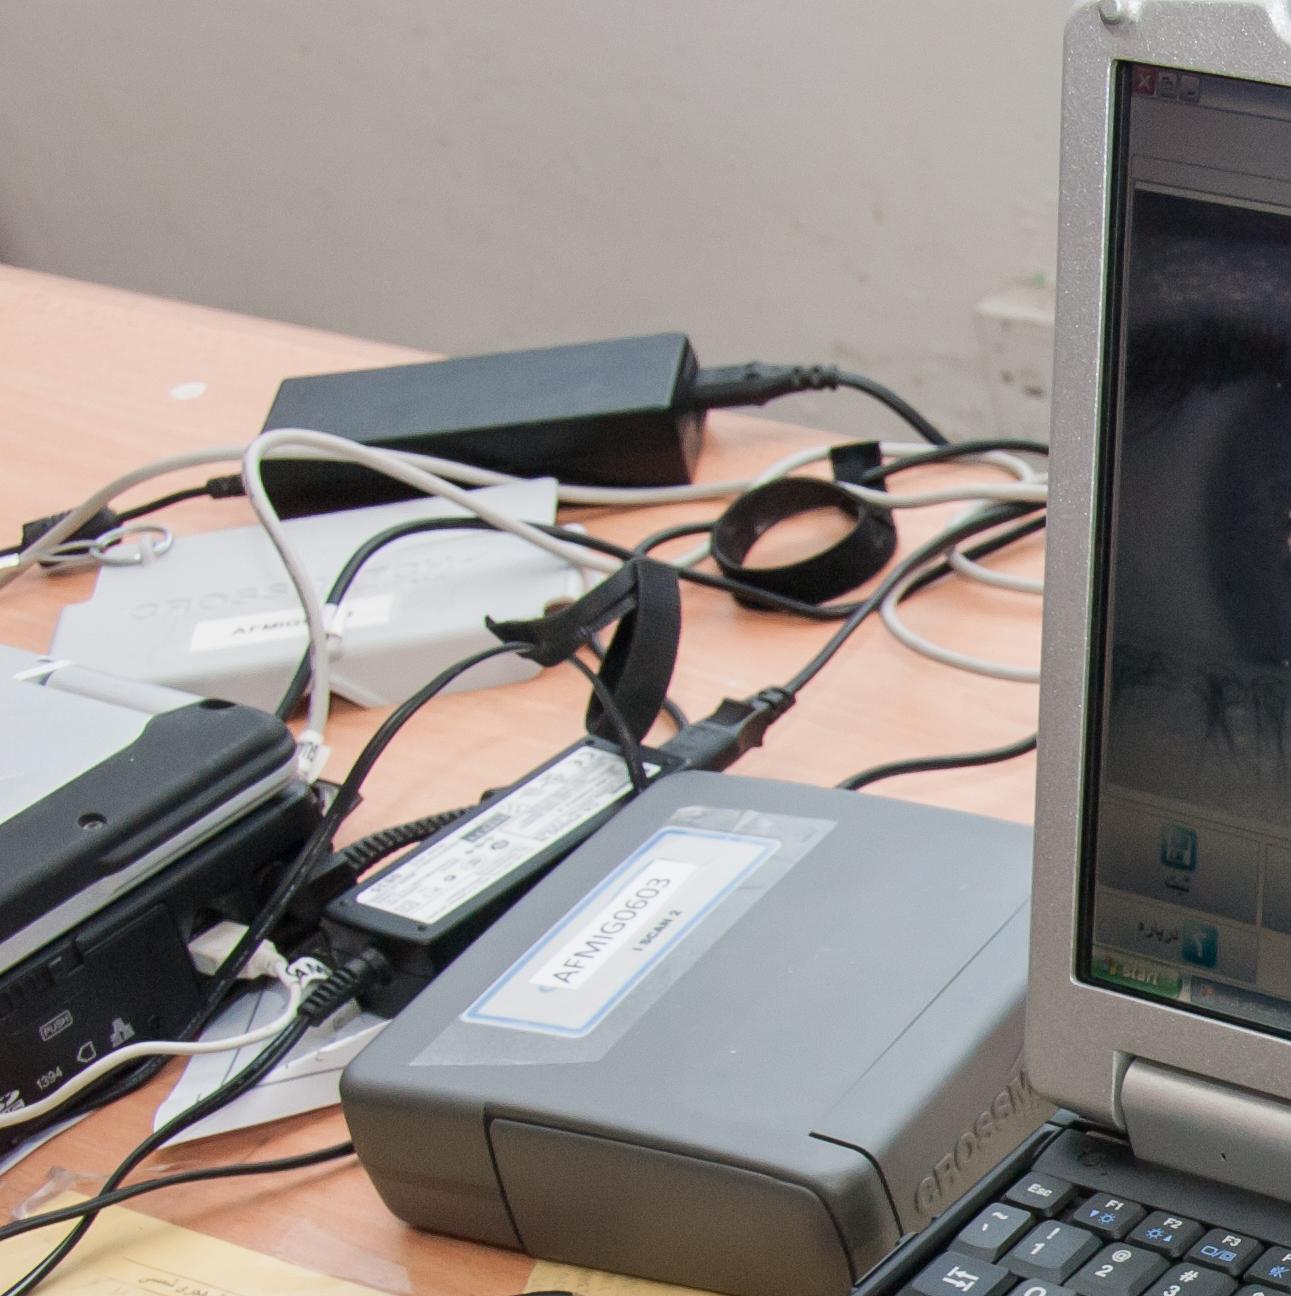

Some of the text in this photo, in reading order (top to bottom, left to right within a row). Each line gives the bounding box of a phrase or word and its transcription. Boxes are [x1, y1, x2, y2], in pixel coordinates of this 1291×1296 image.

[552, 876, 672, 985] AFMIG0603
[639, 916, 674, 946] SCAN
[1028, 1184, 1052, 1196] Esc
[1106, 1200, 1123, 1210] F1
[1164, 1218, 1182, 1228] F2
[1222, 1235, 1241, 1246] F3
[1031, 1243, 1044, 1254] 1
[1095, 1265, 1113, 1277] 2
[1164, 1285, 1180, 1296] 3
